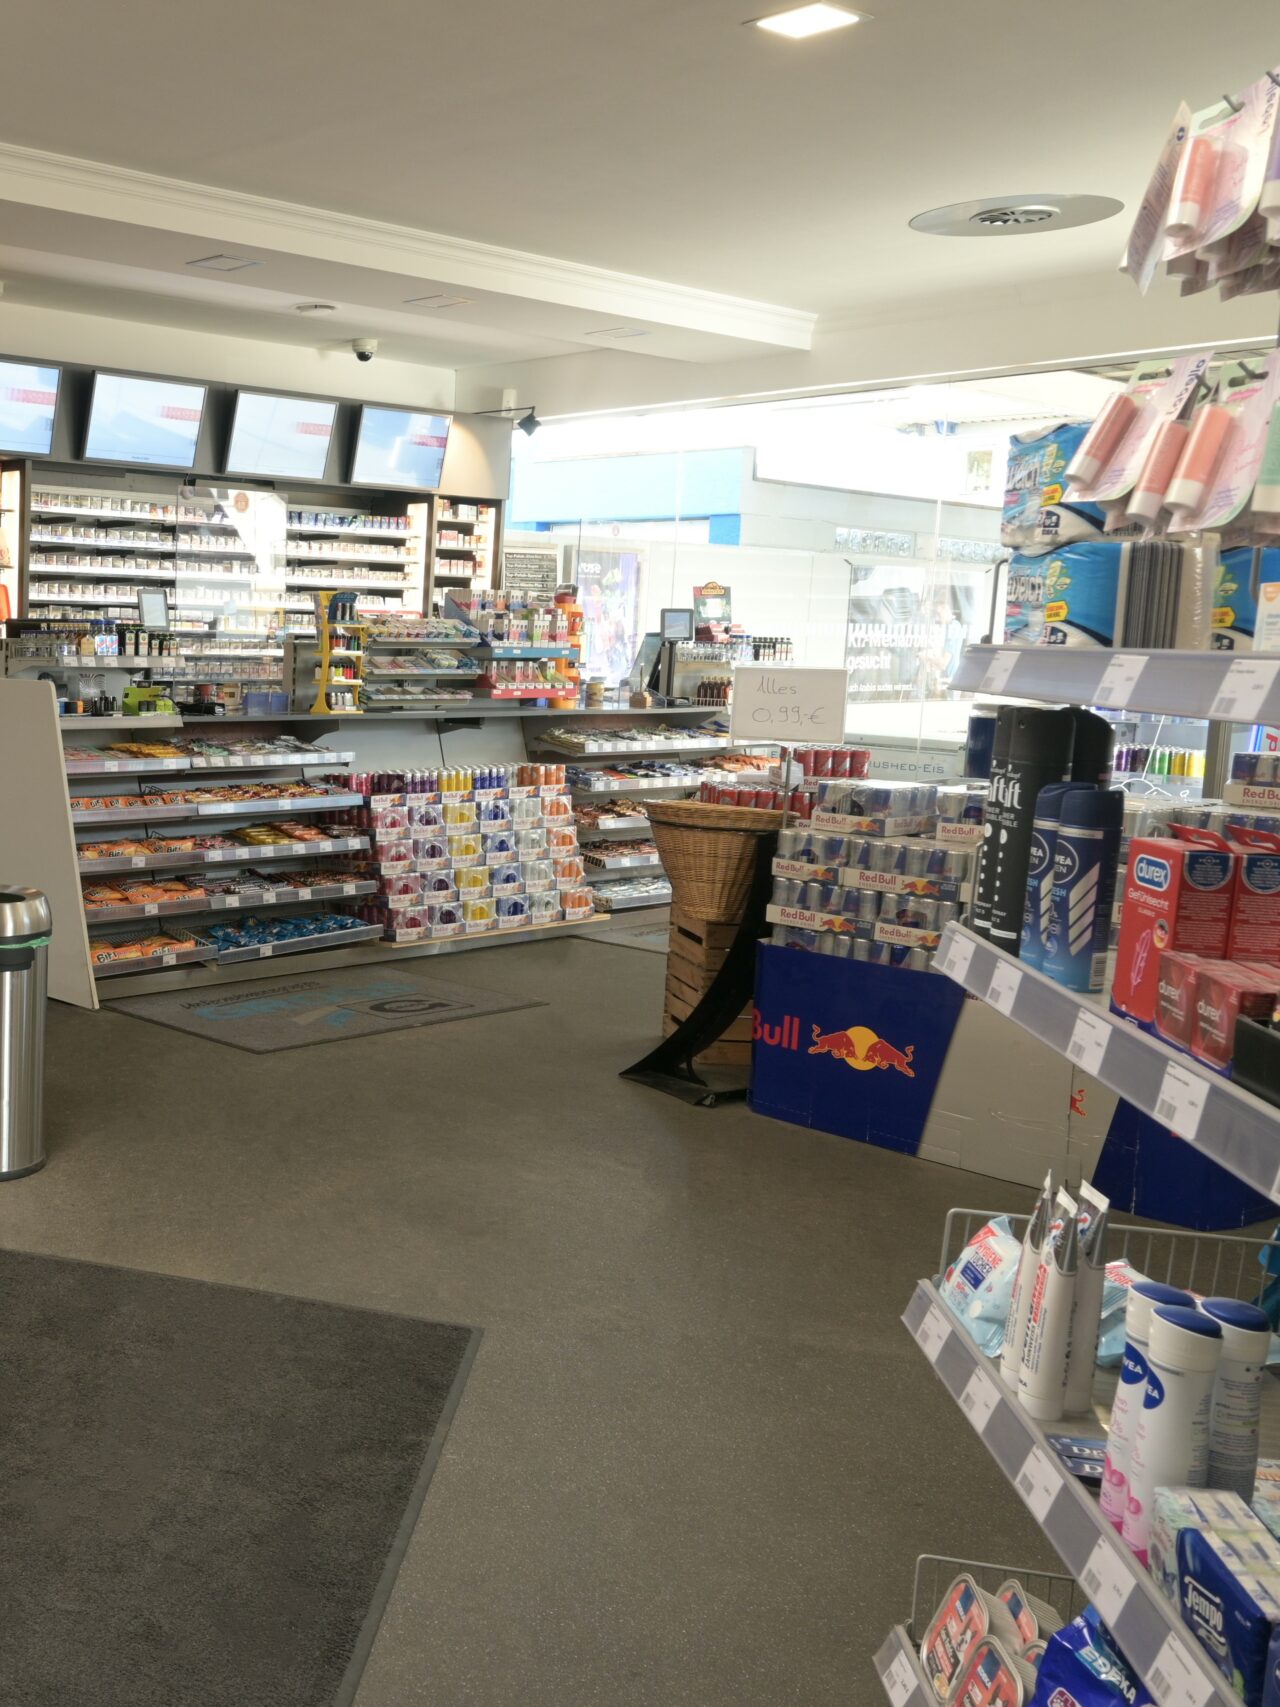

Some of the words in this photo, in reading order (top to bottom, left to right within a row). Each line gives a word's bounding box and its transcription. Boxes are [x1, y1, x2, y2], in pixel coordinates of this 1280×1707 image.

[1242, 787, 1266, 799] Red
[816, 814, 831, 825] Red
[941, 825, 957, 836] Red
[958, 826, 975, 837] Bull
[775, 861, 789, 871] Red
[1137, 860, 1167, 884] durex
[859, 871, 878, 884] Red
[878, 874, 896, 886] Bull
[780, 908, 799, 921] Red
[799, 910, 816, 922] Bull
[880, 926, 896, 937] Red
[896, 928, 912, 938] Bull
[1159, 981, 1181, 1000] durex
[1197, 1001, 1222, 1021] durex
[1183, 1575, 1224, 1633] Tempo
[1078, 1646, 1137, 1705] EDEKA
